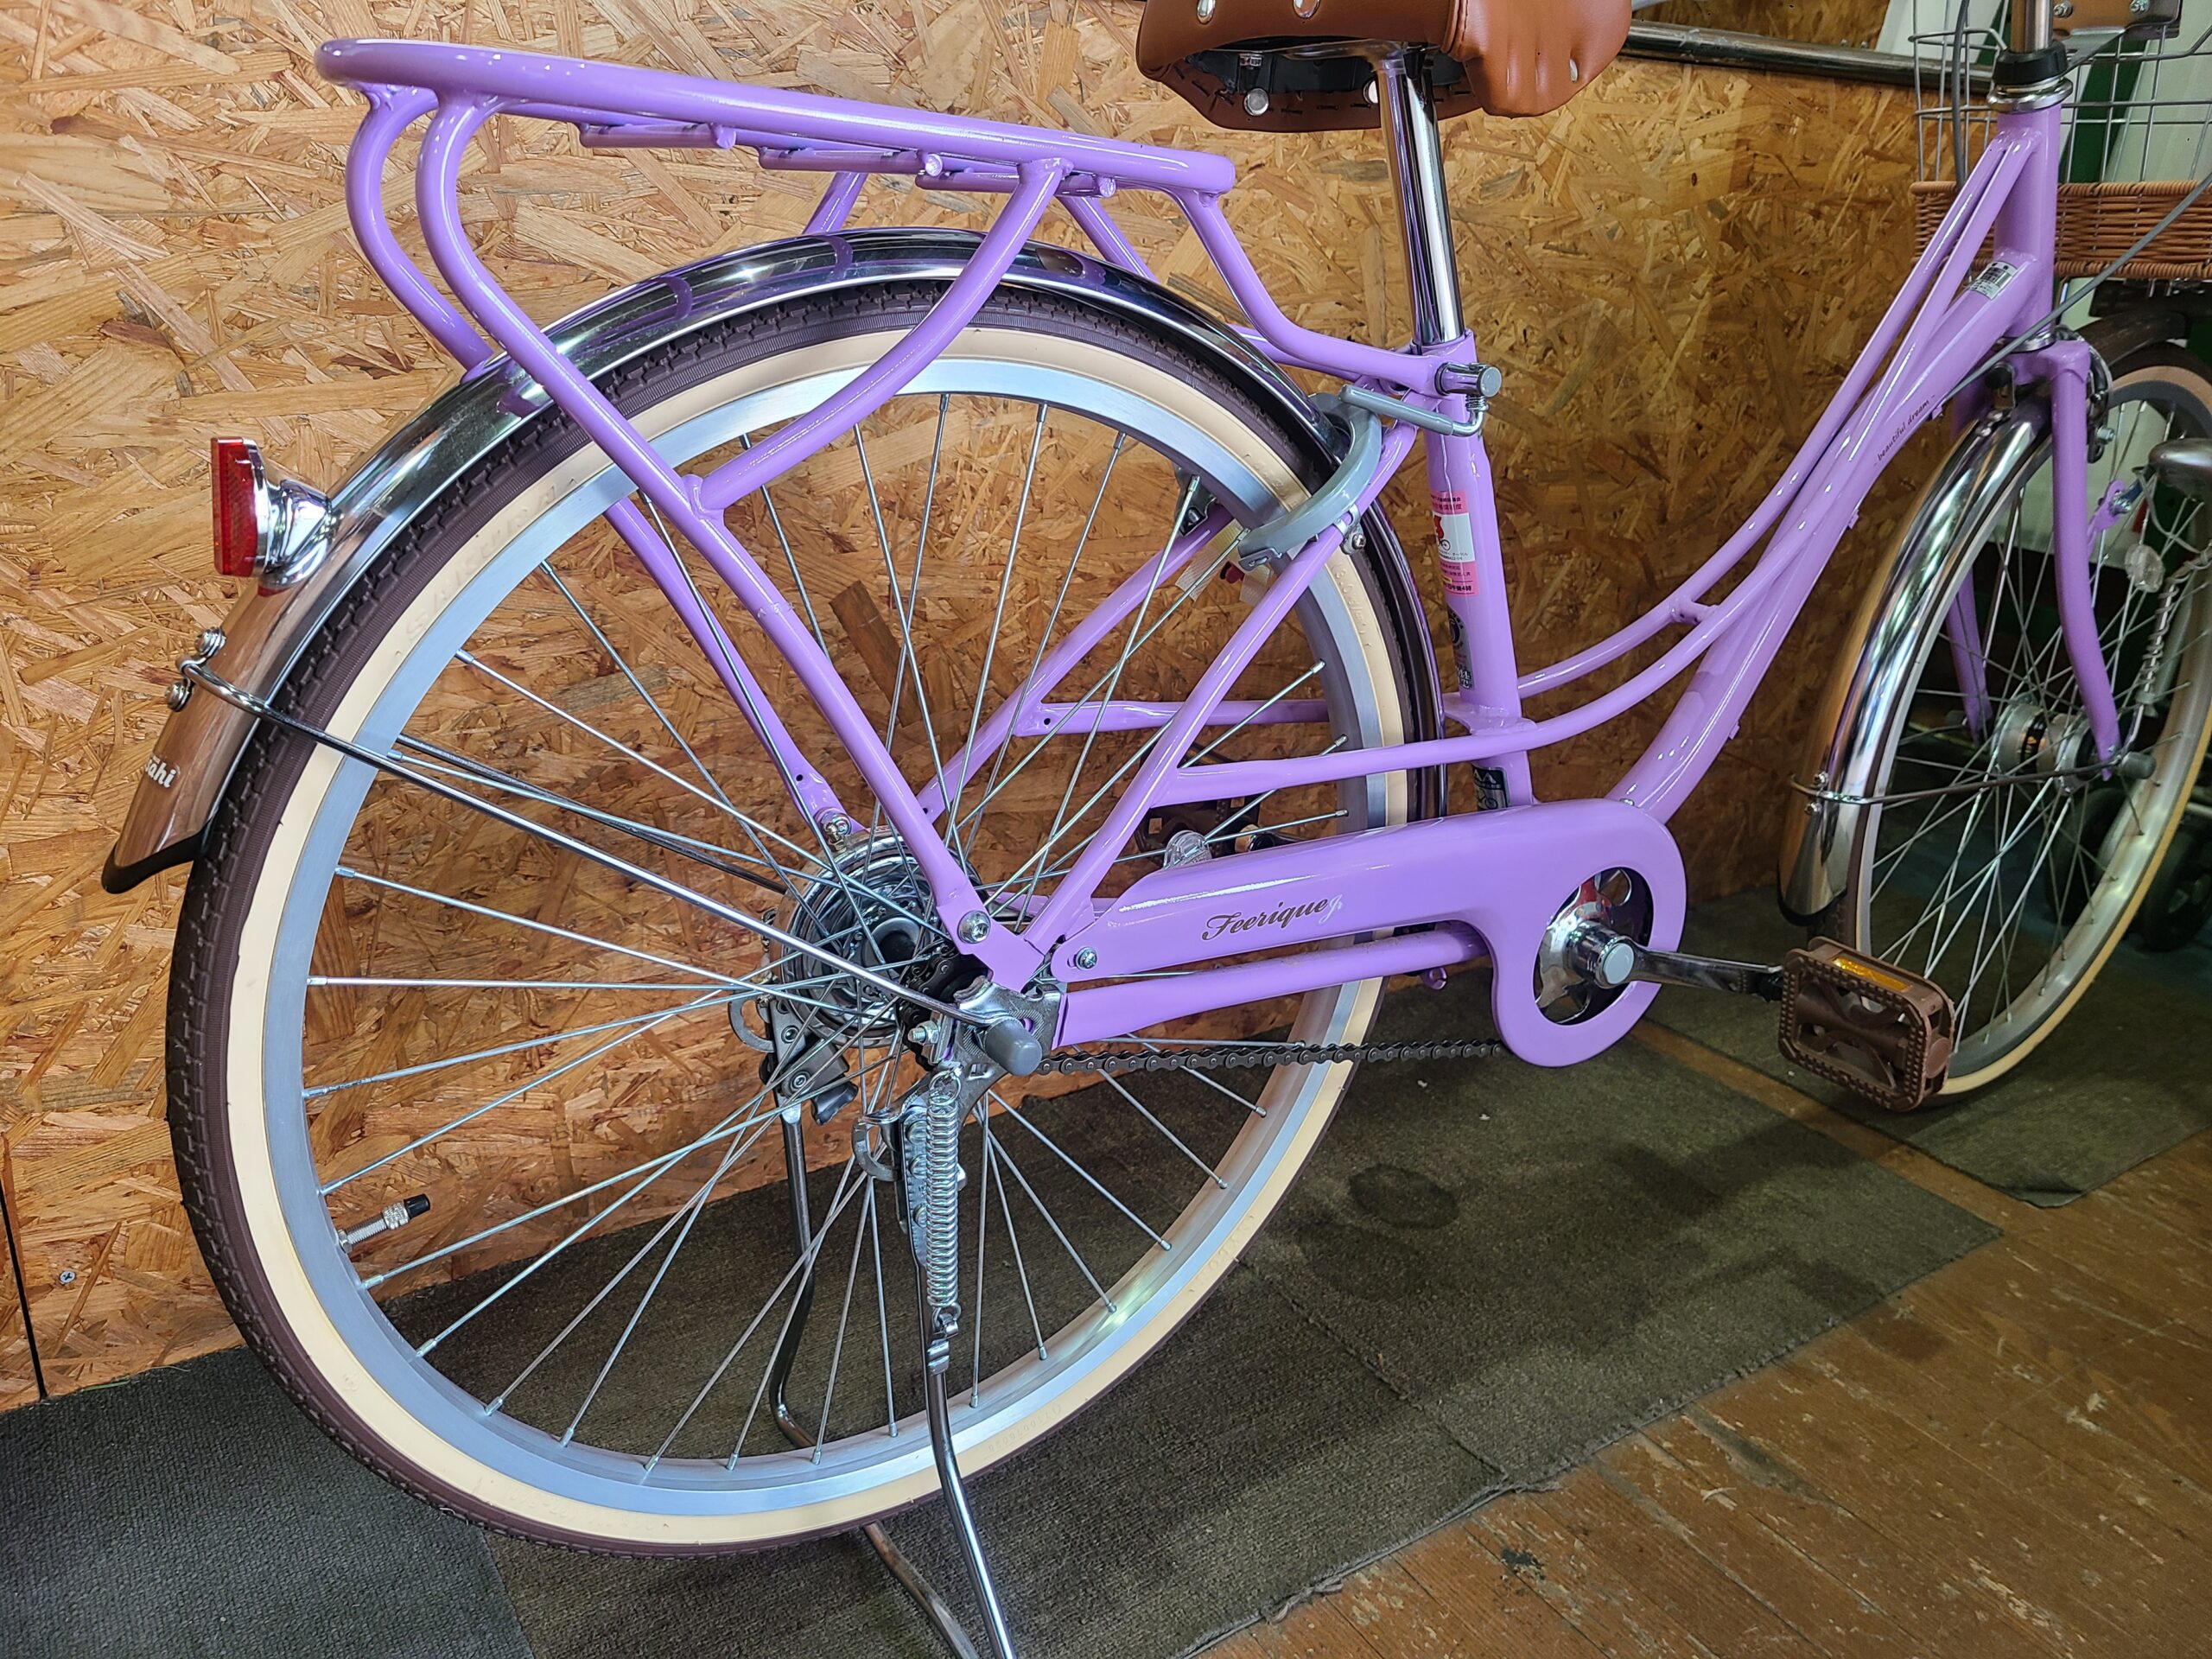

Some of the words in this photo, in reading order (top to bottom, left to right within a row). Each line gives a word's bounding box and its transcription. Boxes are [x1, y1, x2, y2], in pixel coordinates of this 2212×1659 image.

[1877, 422, 1906, 461] beautiful
[1907, 399, 1930, 425] dream
[1201, 898, 1329, 942] Feerique
